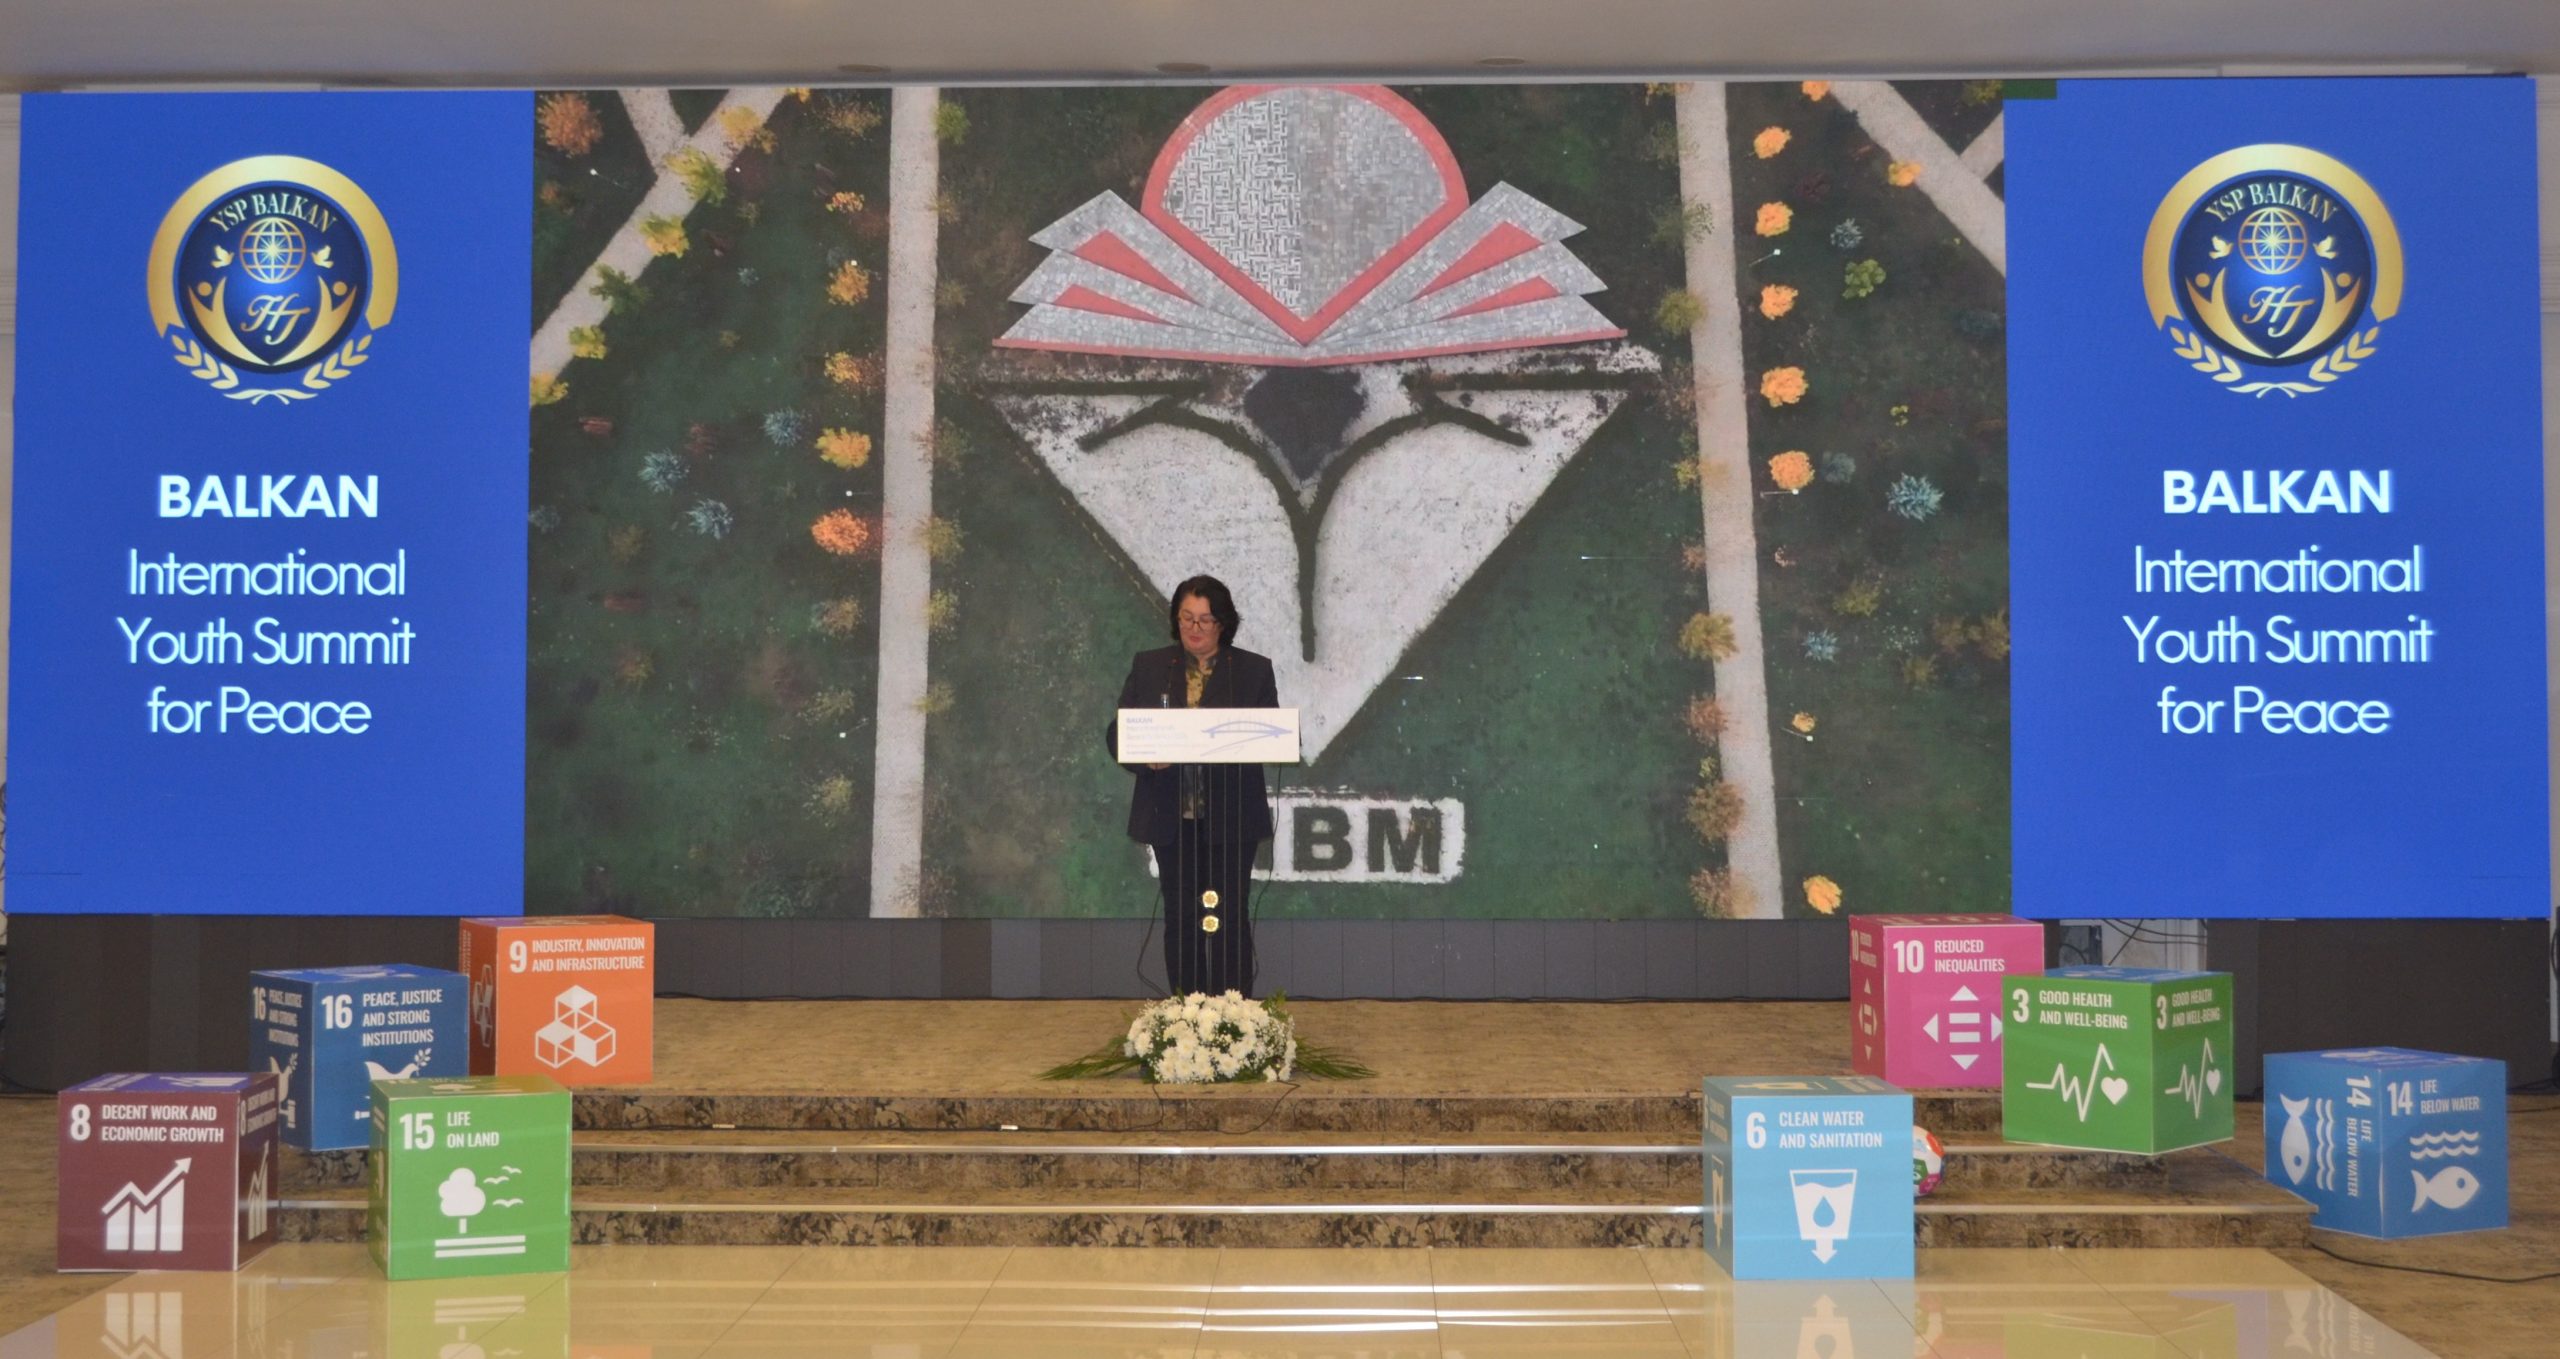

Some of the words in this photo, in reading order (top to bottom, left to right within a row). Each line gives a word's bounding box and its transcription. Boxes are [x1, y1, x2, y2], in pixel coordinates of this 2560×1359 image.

[209, 199, 248, 232] YSP
[251, 192, 337, 233] BALKAN
[2204, 188, 2244, 222] YSP
[2248, 182, 2338, 223] BALKAN
[158, 475, 379, 518] BALKAN
[2163, 470, 2391, 514] BALKAN
[129, 548, 405, 596] International
[2135, 544, 2422, 593] International
[117, 617, 243, 664] Youth
[252, 616, 416, 664] Summit
[2123, 615, 2256, 664] Youth
[2265, 614, 2433, 664] Summit
[147, 686, 212, 733] for
[219, 686, 372, 734] Peace
[2157, 686, 2224, 734] for
[2233, 686, 2391, 735] Peace
[509, 940, 528, 973] 9
[532, 938, 585, 954] INDUSTRY,
[586, 936, 645, 952] INNOVATION
[1893, 940, 1924, 973] 10
[1934, 939, 1984, 954] REDUCED
[532, 959, 554, 972] AND
[556, 956, 645, 972] INFRASTRUCTURE
[1934, 958, 2005, 974] INEQUALITIES
[253, 986, 267, 1021] 16
[321, 994, 353, 1029] 16
[363, 991, 399, 1008] PEACE,
[400, 989, 443, 1005] JUSTICE
[2012, 988, 2030, 1023] 3
[2039, 990, 2069, 1006] GOOD
[2072, 992, 2112, 1008] HEALTH
[2156, 995, 2167, 1030] 3
[362, 1012, 385, 1027] AND
[387, 1010, 430, 1026] STRONG
[2039, 1010, 2061, 1025] AND
[2064, 1012, 2128, 1030] WELL-BEING
[362, 1028, 434, 1047] INSTITUTIONS
[2346, 1075, 2372, 1108] 14
[2387, 1080, 2413, 1116] 14
[2420, 1079, 2438, 1094] LIFE
[102, 1105, 148, 1120] DECENT
[151, 1105, 188, 1121] WORK
[190, 1106, 217, 1121] AND
[447, 1111, 471, 1127] LIFE
[1779, 1111, 1818, 1127] CLEAN
[1822, 1111, 1864, 1126] WATER
[2420, 1098, 2449, 1114] BELOW
[2451, 1096, 2480, 1112] WATER
[70, 1104, 91, 1141] 8
[102, 1127, 167, 1142] ECONOMIC
[169, 1127, 224, 1143] GROWTH
[399, 1112, 435, 1150] 15
[1746, 1111, 1767, 1149] 6
[2346, 1117, 2359, 1158] BELOW
[2360, 1119, 2372, 1143] LIFE
[447, 1133, 465, 1148] ON
[467, 1131, 499, 1147] LAND
[1779, 1133, 1805, 1148] AND
[1809, 1132, 1882, 1148] SANITATION
[2347, 1159, 2359, 1197] WATER
